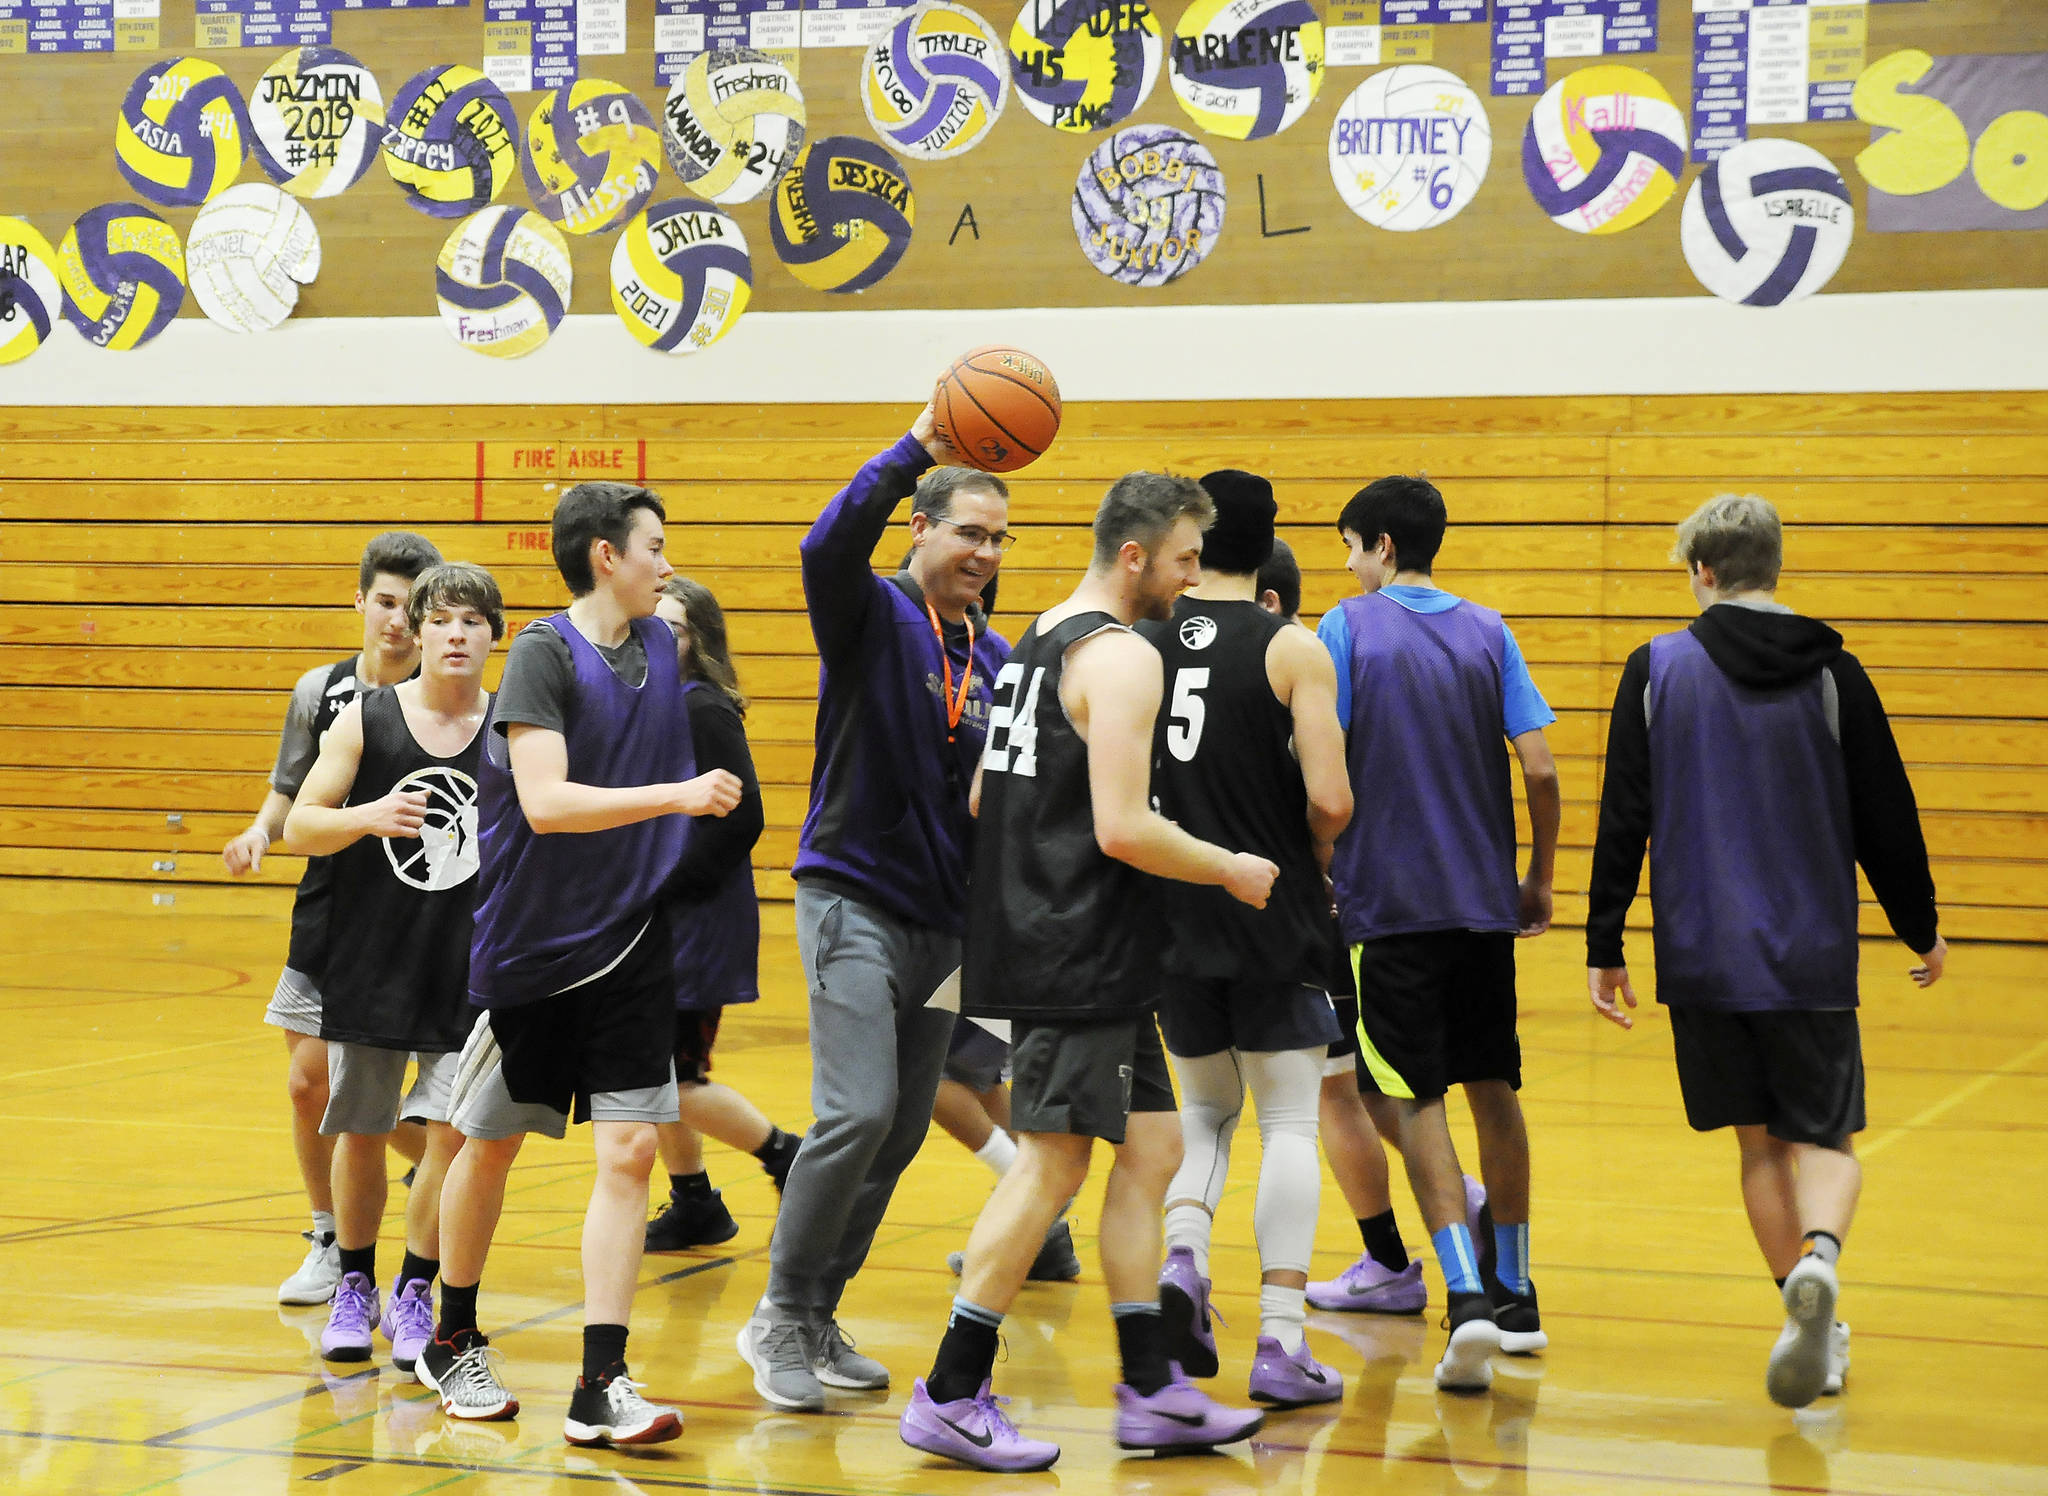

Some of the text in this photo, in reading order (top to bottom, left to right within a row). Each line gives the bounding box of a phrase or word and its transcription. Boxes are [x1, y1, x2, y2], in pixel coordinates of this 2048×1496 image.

[148, 75, 191, 102] 2019
[262, 73, 360, 103] JAZMIN
[714, 67, 787, 101] Freshman
[874, 46, 914, 114] #28
[1019, 50, 1065, 87] 45
[284, 102, 354, 141] 2019
[918, 87, 979, 152] JUNIOR
[1204, 91, 1237, 109] 2019
[1565, 92, 1636, 135] Kalli
[132, 118, 183, 154] ASIA
[666, 93, 722, 168] AMANDA
[1337, 117, 1472, 155] BRITTNEY
[286, 141, 338, 169] #44
[1097, 151, 1197, 194] BOBBI
[559, 163, 652, 229] Alissa
[1256, 174, 1311, 238] L
[652, 212, 724, 256] JAYLA
[949, 203, 981, 246] A
[1091, 223, 1201, 270] JUNIOR
[619, 280, 670, 330] 2021
[458, 315, 529, 342] Freshman
[513, 449, 624, 469] FIRE AISLE
[507, 532, 550, 551] FIRE
[982, 661, 1047, 778] 24
[1167, 667, 1211, 763] 5
